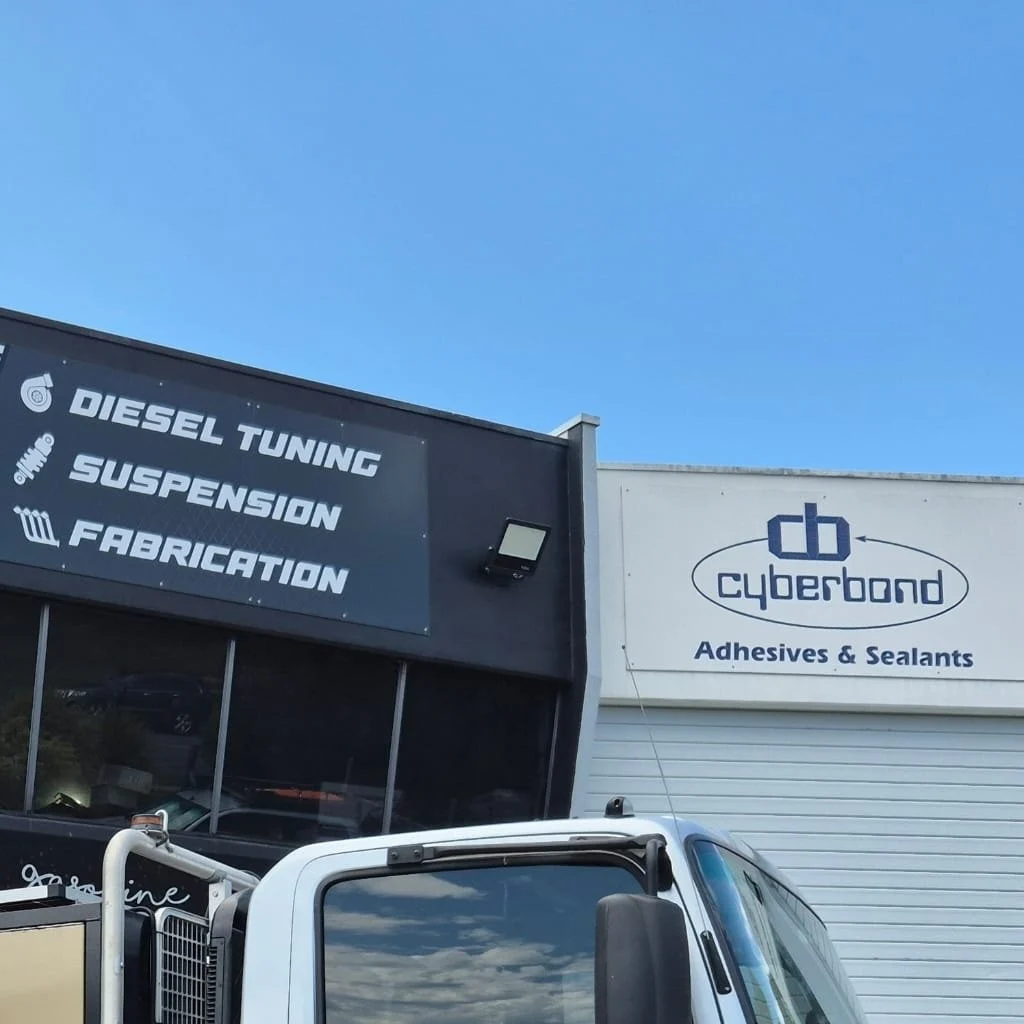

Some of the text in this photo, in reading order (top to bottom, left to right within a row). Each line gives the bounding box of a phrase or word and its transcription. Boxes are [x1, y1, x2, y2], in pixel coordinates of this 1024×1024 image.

[69, 388, 382, 478] DIESEL TUNING
[69, 454, 343, 531] SUSPENSION
[69, 520, 350, 595] FABRICATION
[718, 564, 944, 610] cyberbond
[694, 641, 974, 668] Adhesives & Sealants
